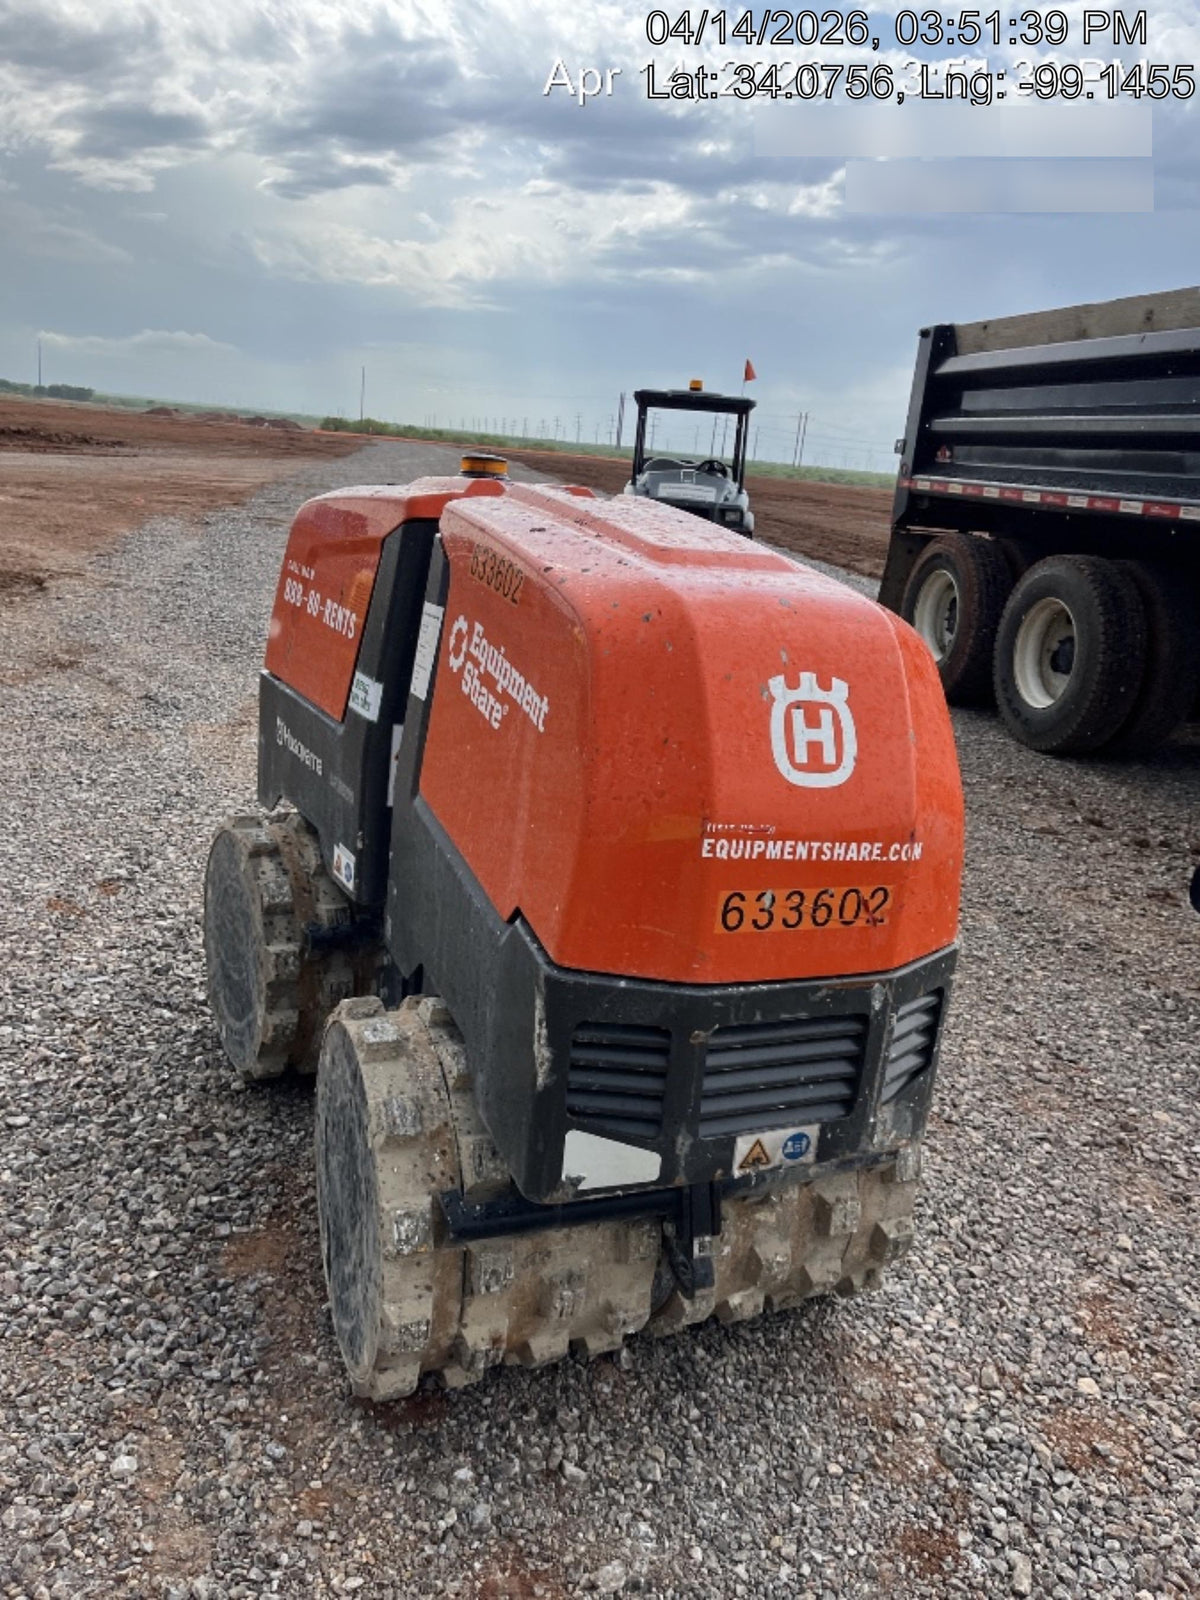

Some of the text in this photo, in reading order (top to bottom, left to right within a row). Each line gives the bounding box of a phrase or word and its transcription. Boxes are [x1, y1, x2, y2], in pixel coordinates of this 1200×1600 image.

[470, 543, 524, 605] 633602
[469, 621, 549, 733] Equipment
[721, 886, 889, 932] 633602
